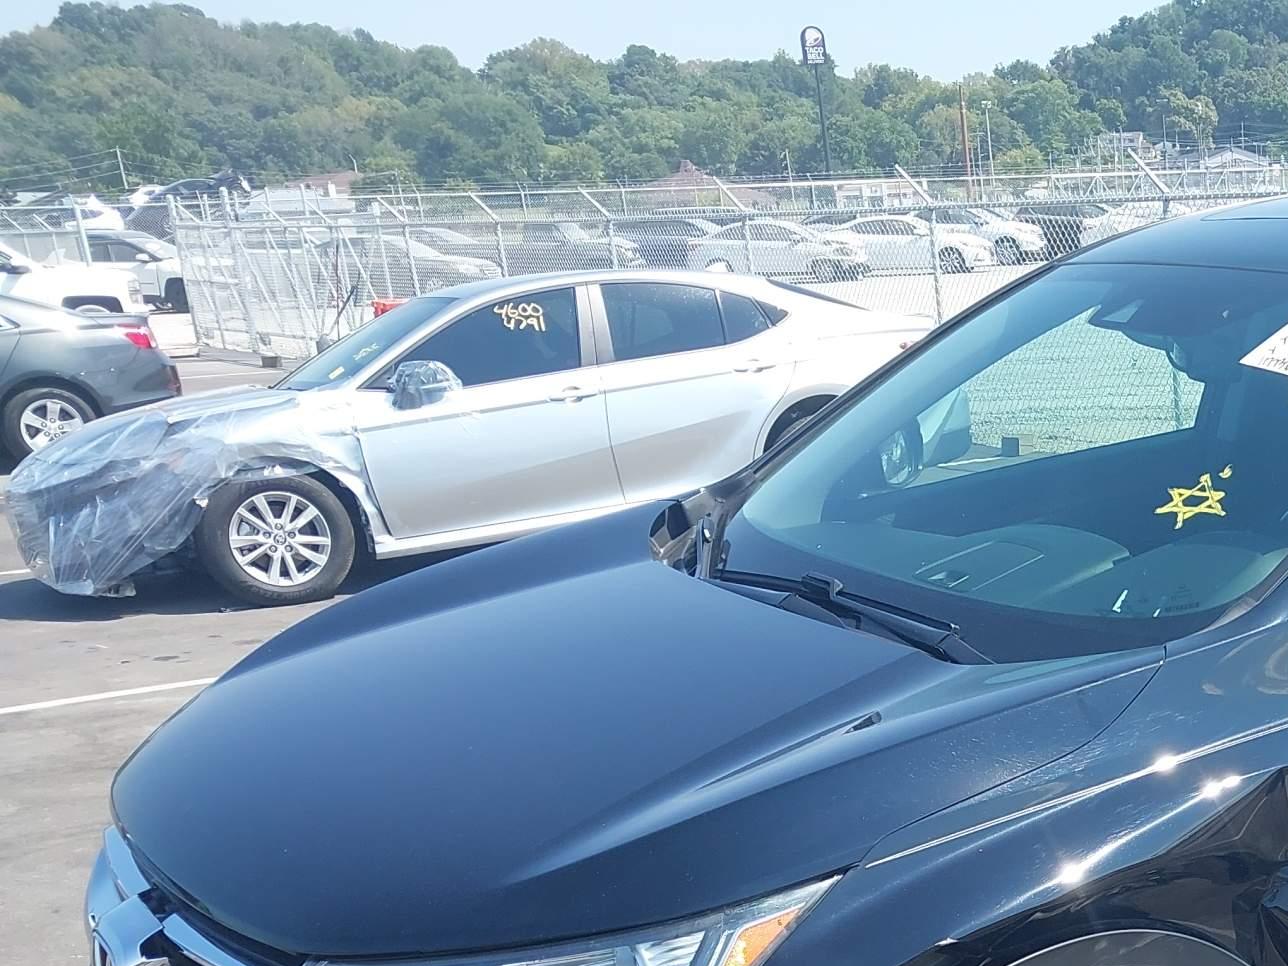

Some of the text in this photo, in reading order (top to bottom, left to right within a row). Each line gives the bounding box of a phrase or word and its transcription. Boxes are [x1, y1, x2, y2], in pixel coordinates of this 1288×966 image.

[804, 46, 824, 54] TACO
[493, 302, 543, 319] 4600
[503, 316, 546, 332] 4791
